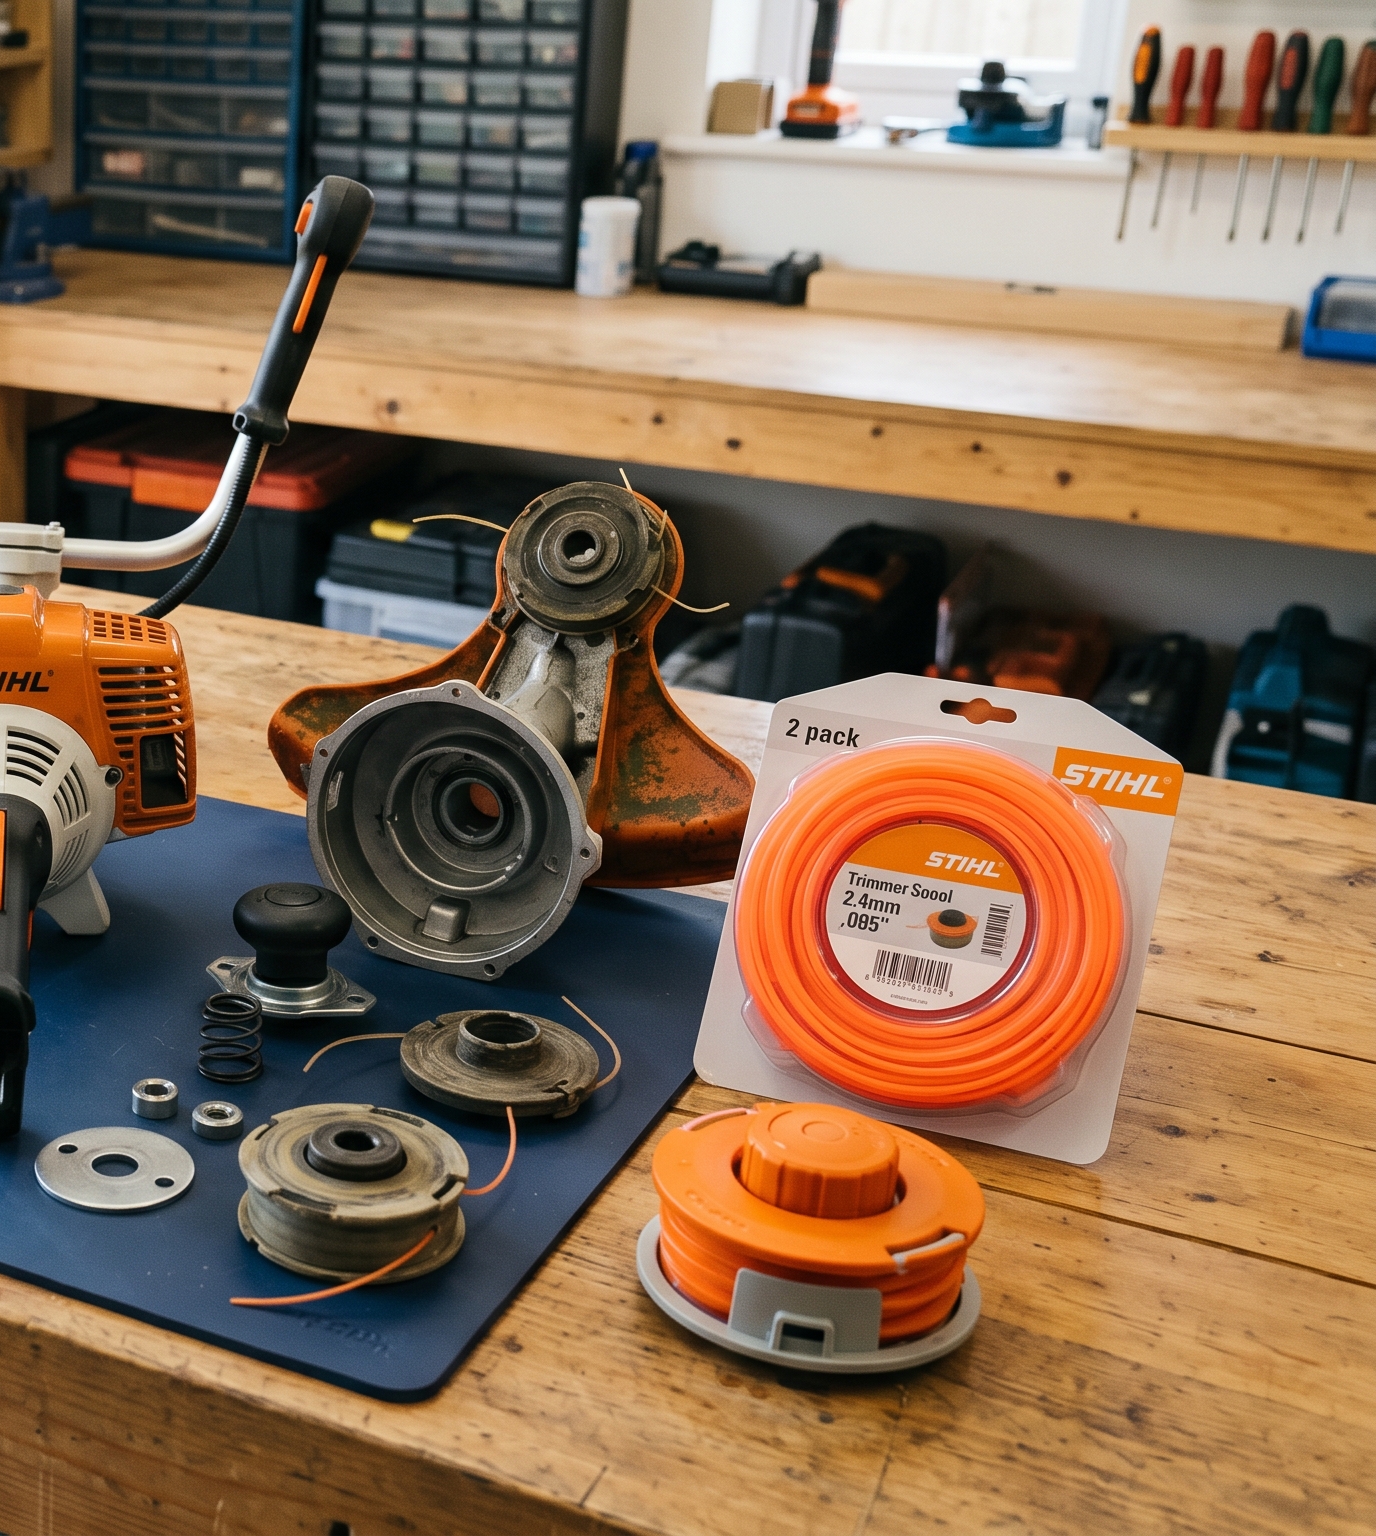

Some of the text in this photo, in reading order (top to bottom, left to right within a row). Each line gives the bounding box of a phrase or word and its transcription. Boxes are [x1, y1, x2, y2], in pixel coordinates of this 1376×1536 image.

[785, 718, 860, 748] 2 pack
[1060, 763, 1165, 799] STIHL
[924, 851, 1001, 878] STIHL
[848, 871, 953, 903] Trimmer Soool
[842, 890, 901, 915] 2.4mm
